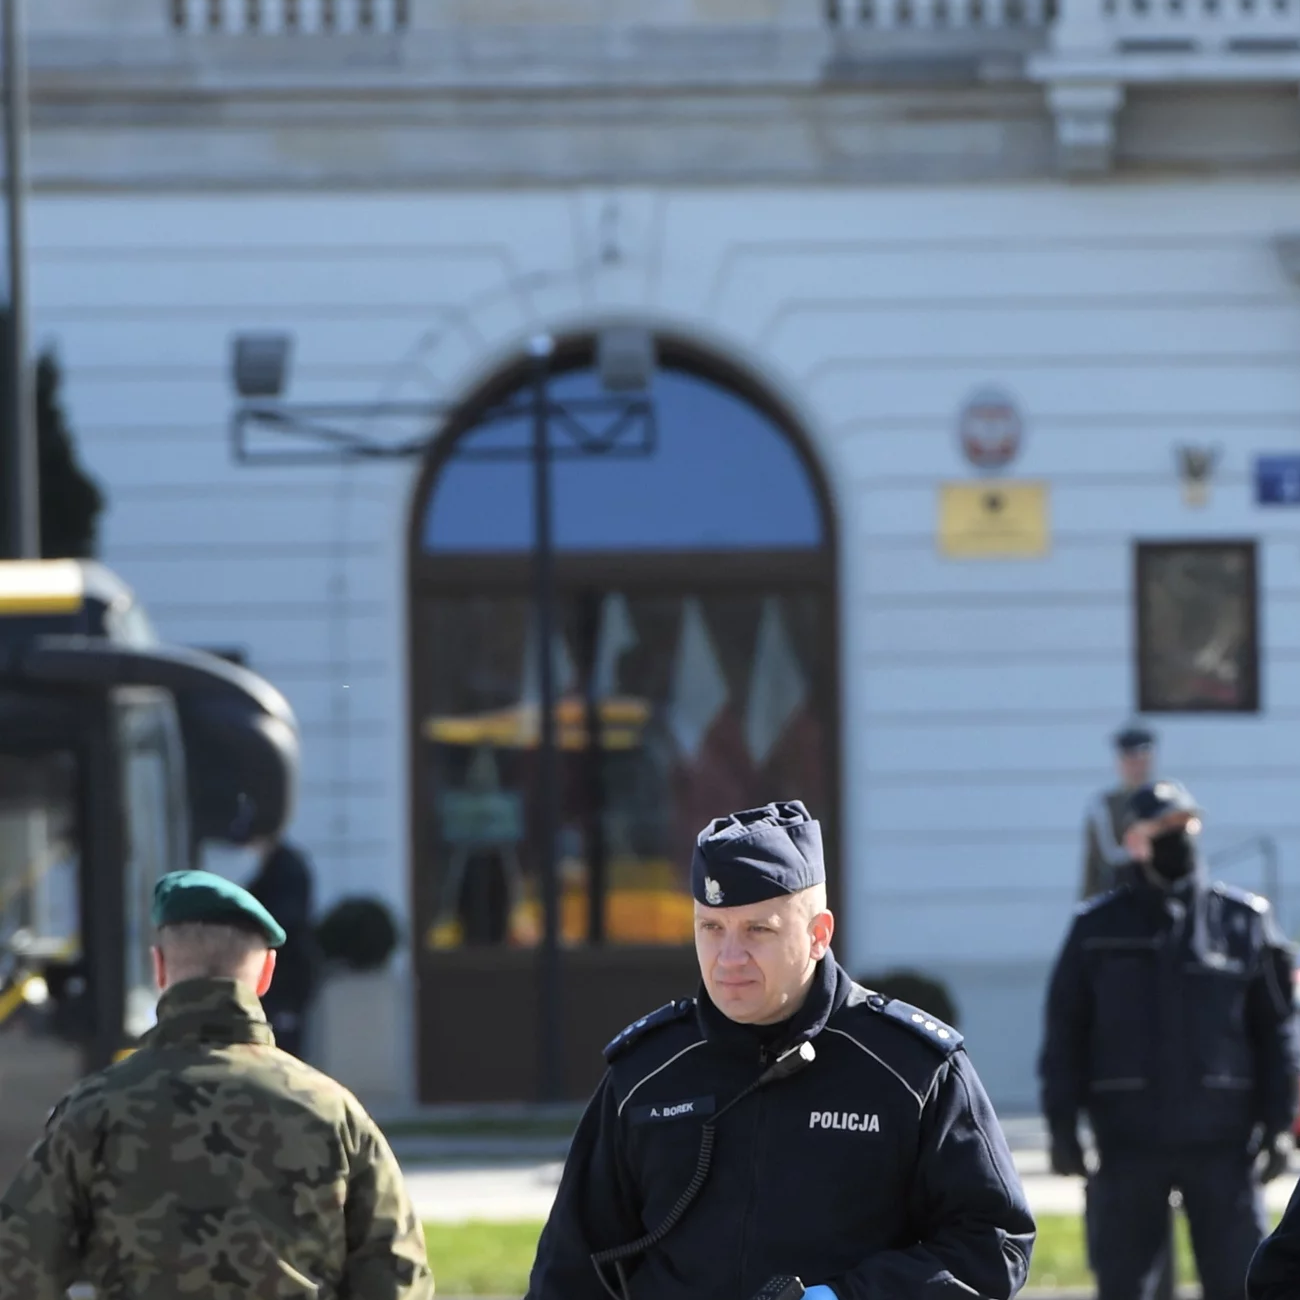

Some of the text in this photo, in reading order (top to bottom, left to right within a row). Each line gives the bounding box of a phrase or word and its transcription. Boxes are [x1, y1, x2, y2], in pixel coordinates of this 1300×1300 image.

[650, 1102, 695, 1118] A. BOREK
[809, 1111, 880, 1132] POLICJA
